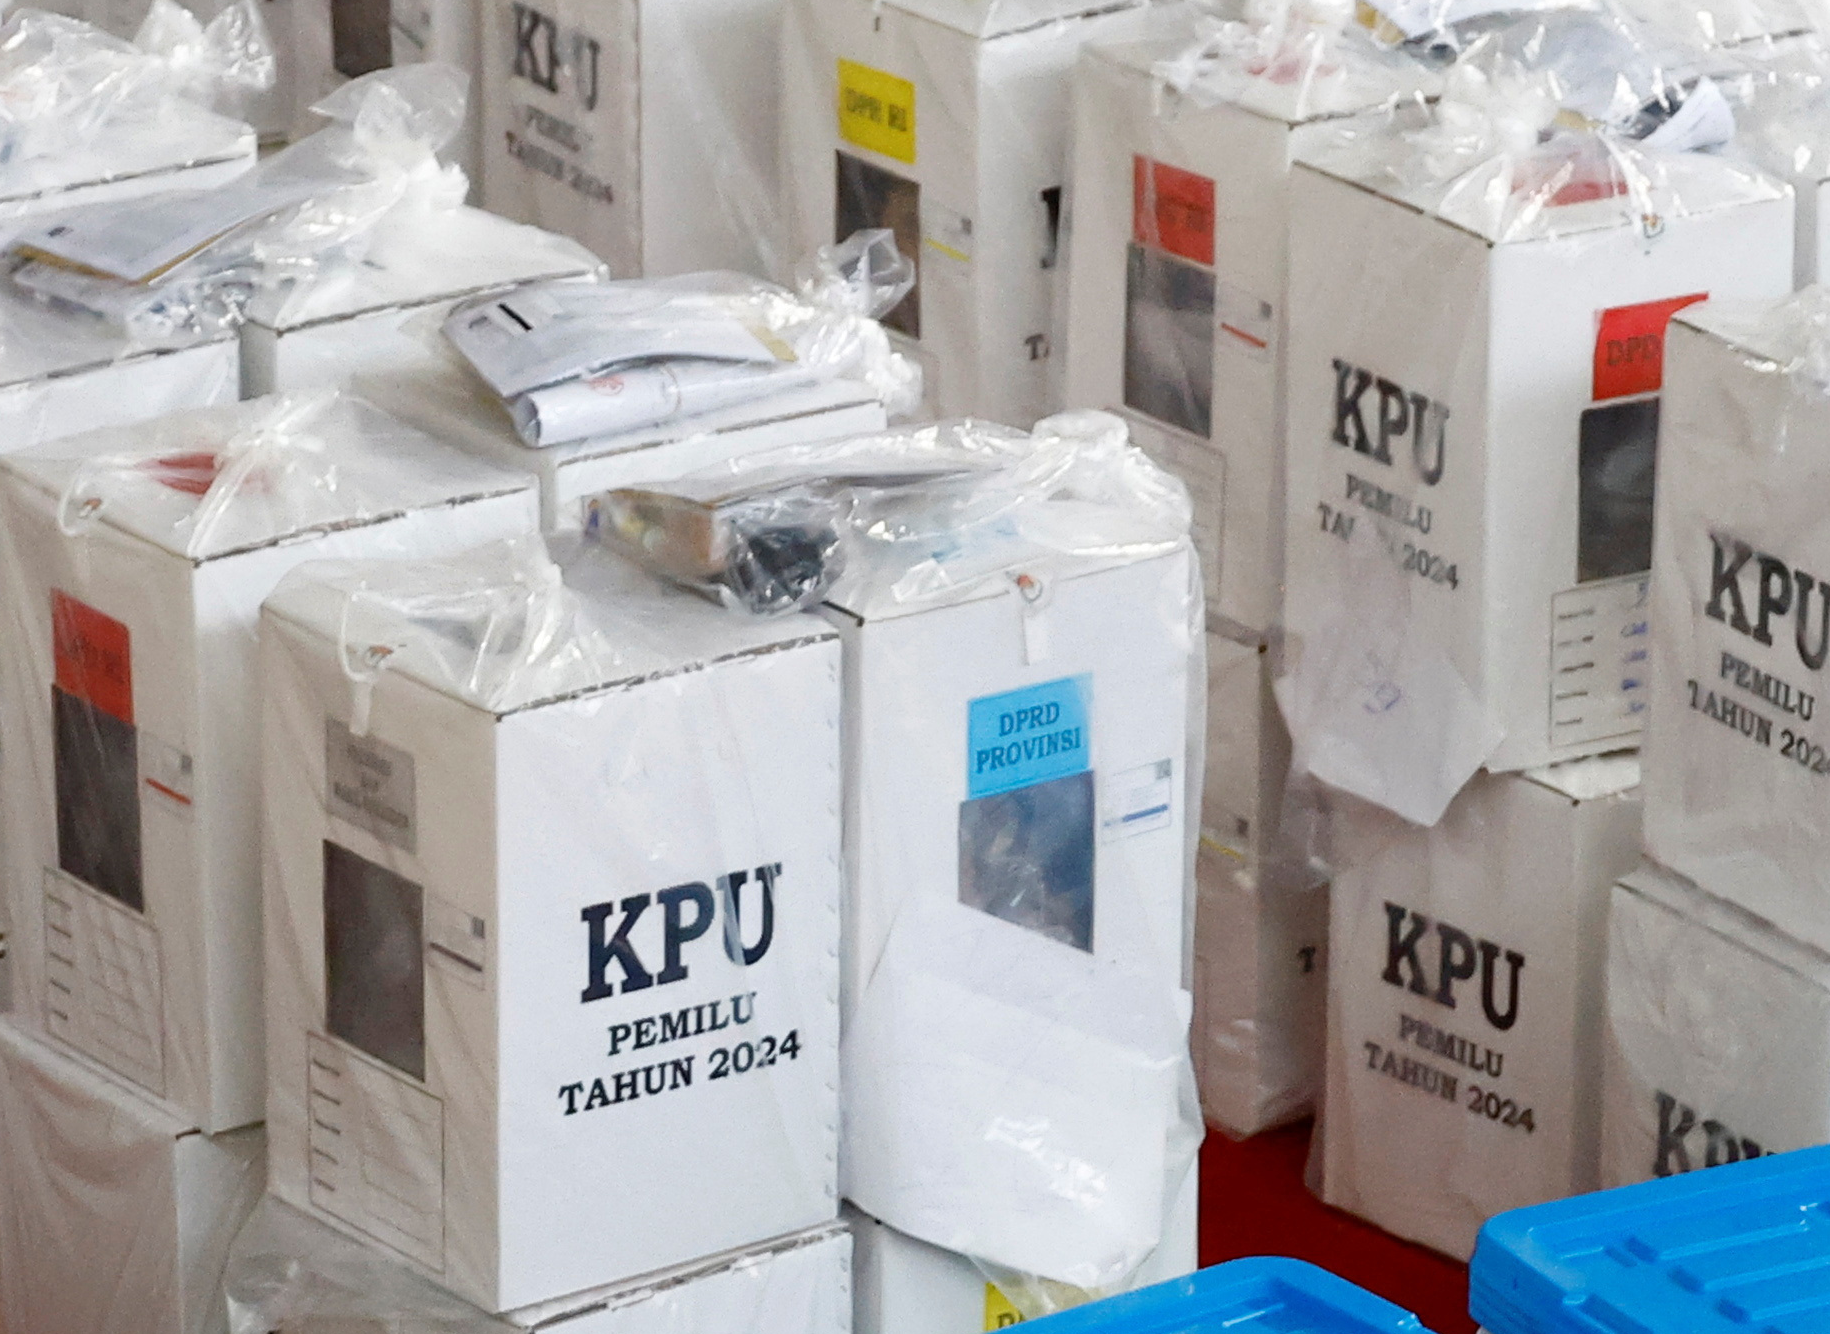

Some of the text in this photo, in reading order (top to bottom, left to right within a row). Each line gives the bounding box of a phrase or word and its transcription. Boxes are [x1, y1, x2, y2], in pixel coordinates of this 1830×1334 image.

[1331, 356, 1450, 488] KPU
[1403, 541, 1460, 591] 2024
[999, 701, 1060, 738] DPRD
[1687, 679, 1776, 749] TAHUN
[1719, 649, 1817, 723] PEMILU
[976, 727, 1083, 774] PROVINSI
[581, 863, 783, 1005] KPU
[1381, 901, 1525, 1032] KPU
[607, 992, 757, 1057] PEMILU
[1399, 1012, 1504, 1079] PEMILU
[559, 1028, 802, 1117] TAHUN 2024
[1364, 1039, 1536, 1136] TAHUN 2024
